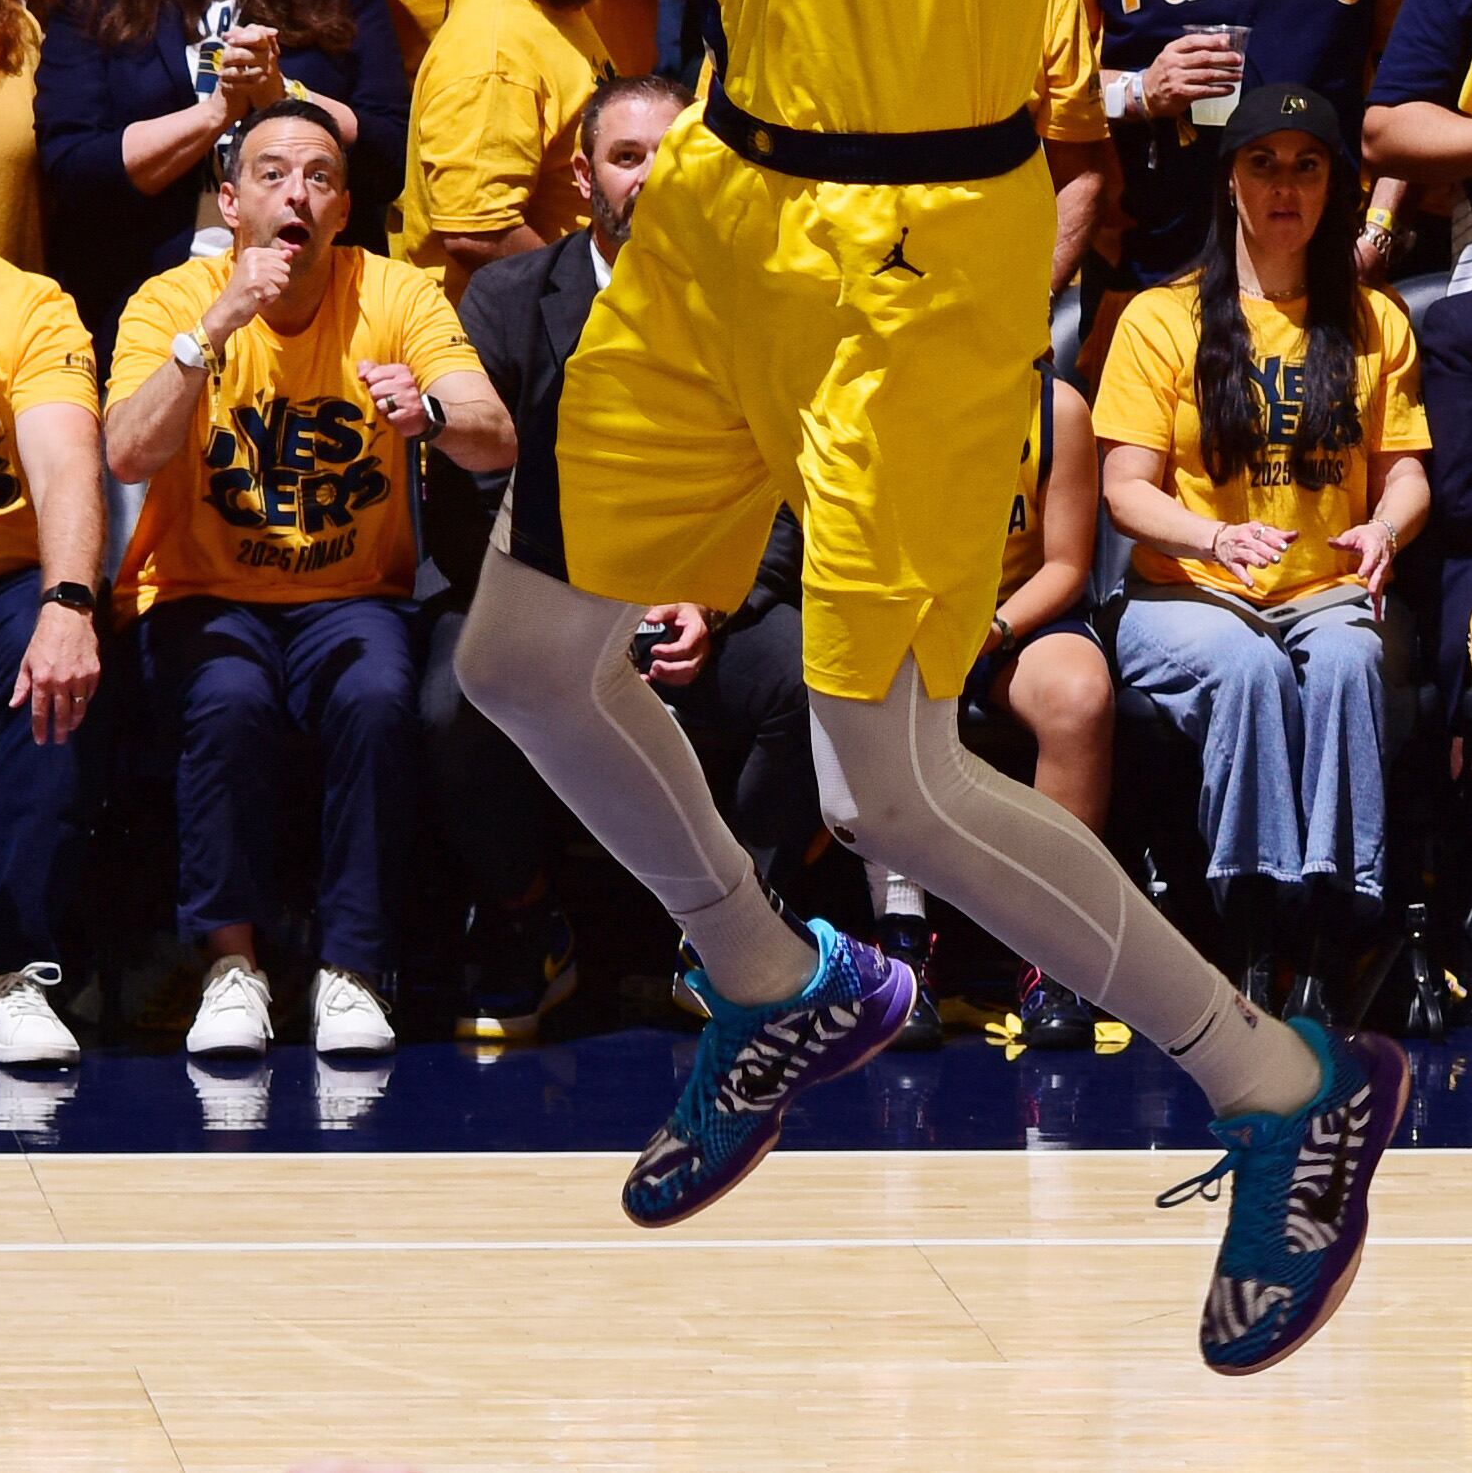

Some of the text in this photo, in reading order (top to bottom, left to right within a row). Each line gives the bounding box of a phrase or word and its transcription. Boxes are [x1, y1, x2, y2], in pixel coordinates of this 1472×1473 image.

[229, 396, 366, 471] YES
[1251, 459, 1292, 488] 2025
[236, 529, 357, 571] 2025 FINALS
